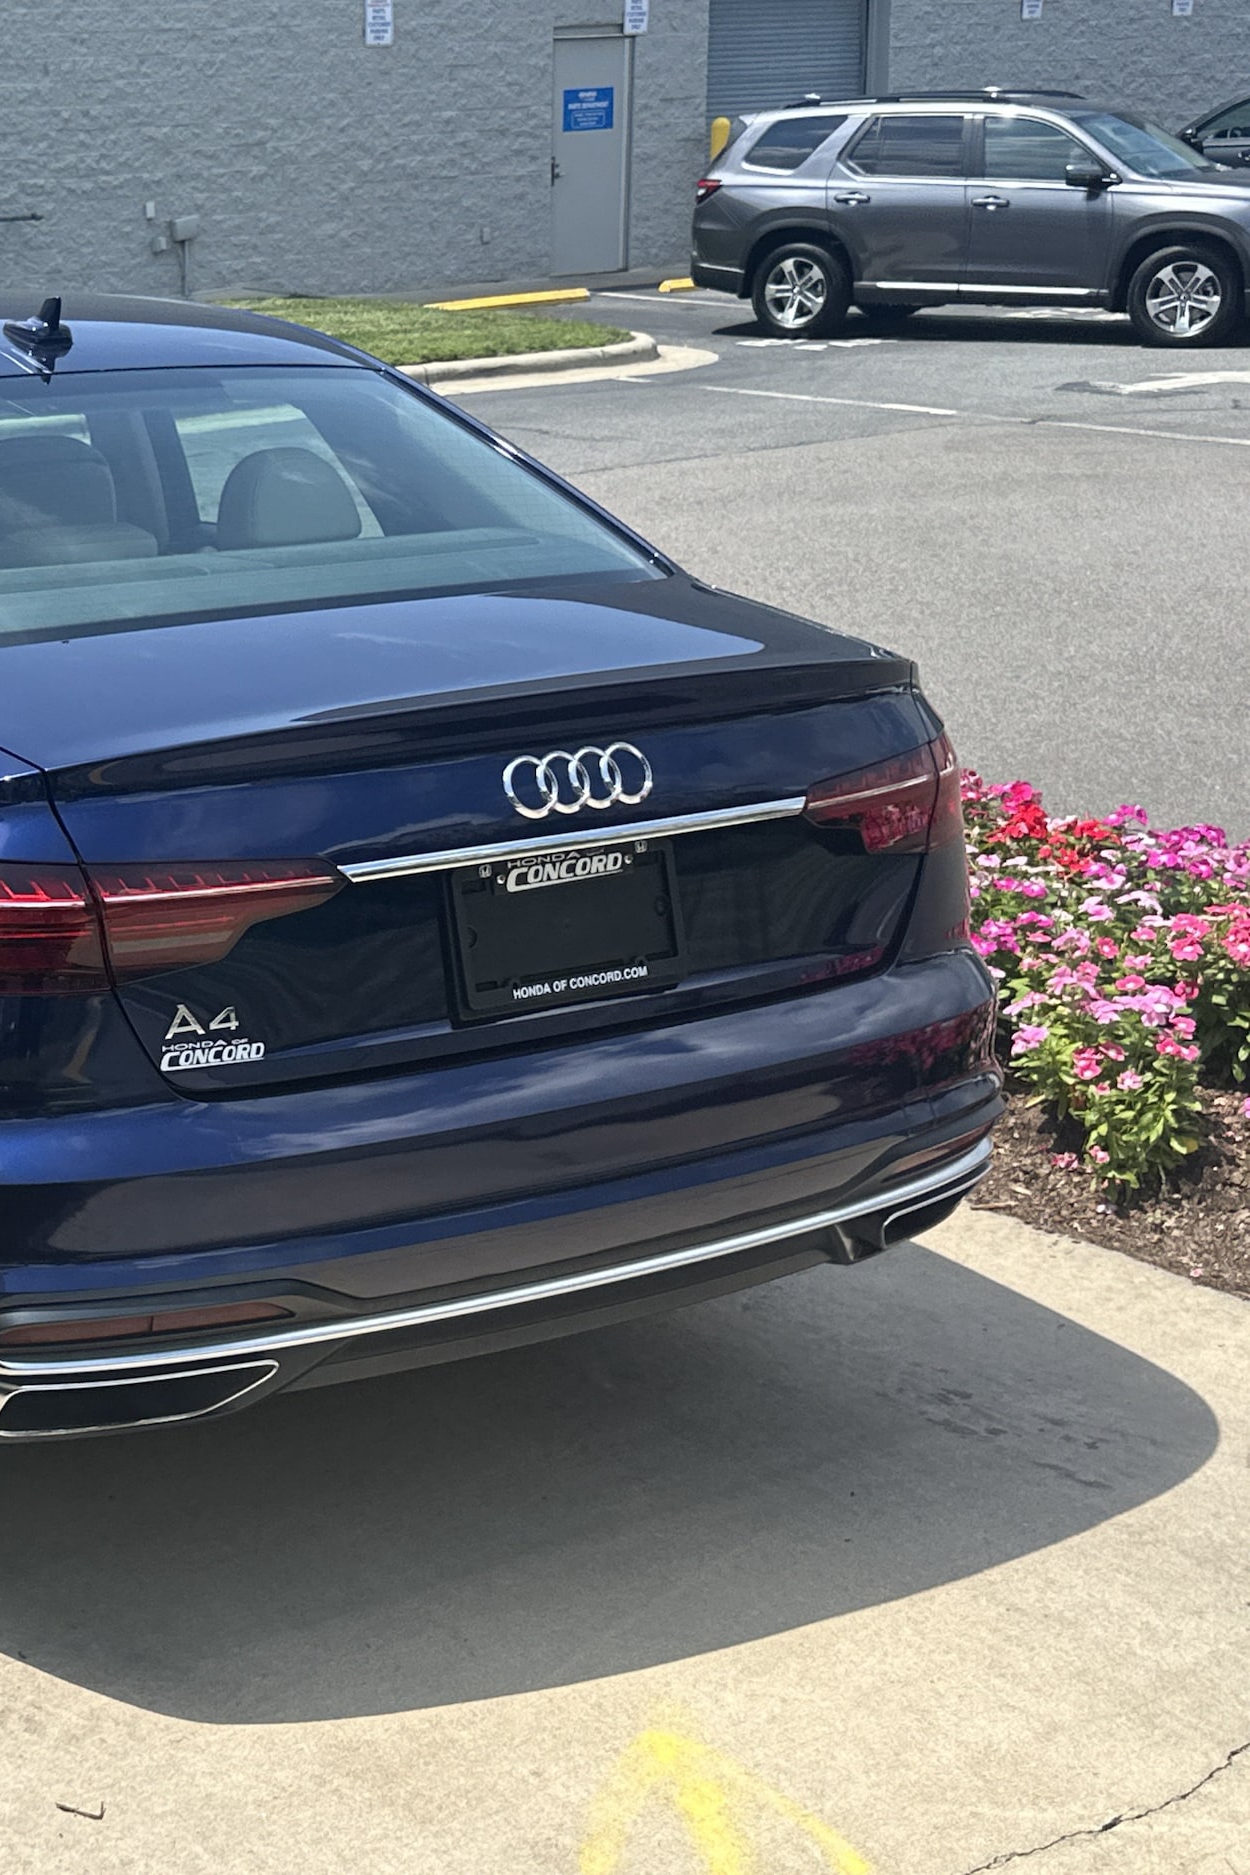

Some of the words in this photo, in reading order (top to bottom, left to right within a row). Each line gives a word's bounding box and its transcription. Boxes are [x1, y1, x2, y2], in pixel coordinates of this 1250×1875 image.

[506, 852, 623, 892] CONCORD
[507, 851, 581, 868] HONDA
[513, 984, 551, 1000] HONDA
[553, 979, 568, 993] OF
[569, 965, 648, 990] CONCORD.COM
[164, 1004, 239, 1039] A4
[160, 1042, 265, 1071] CONCORD
[161, 1039, 227, 1052] HONDA
